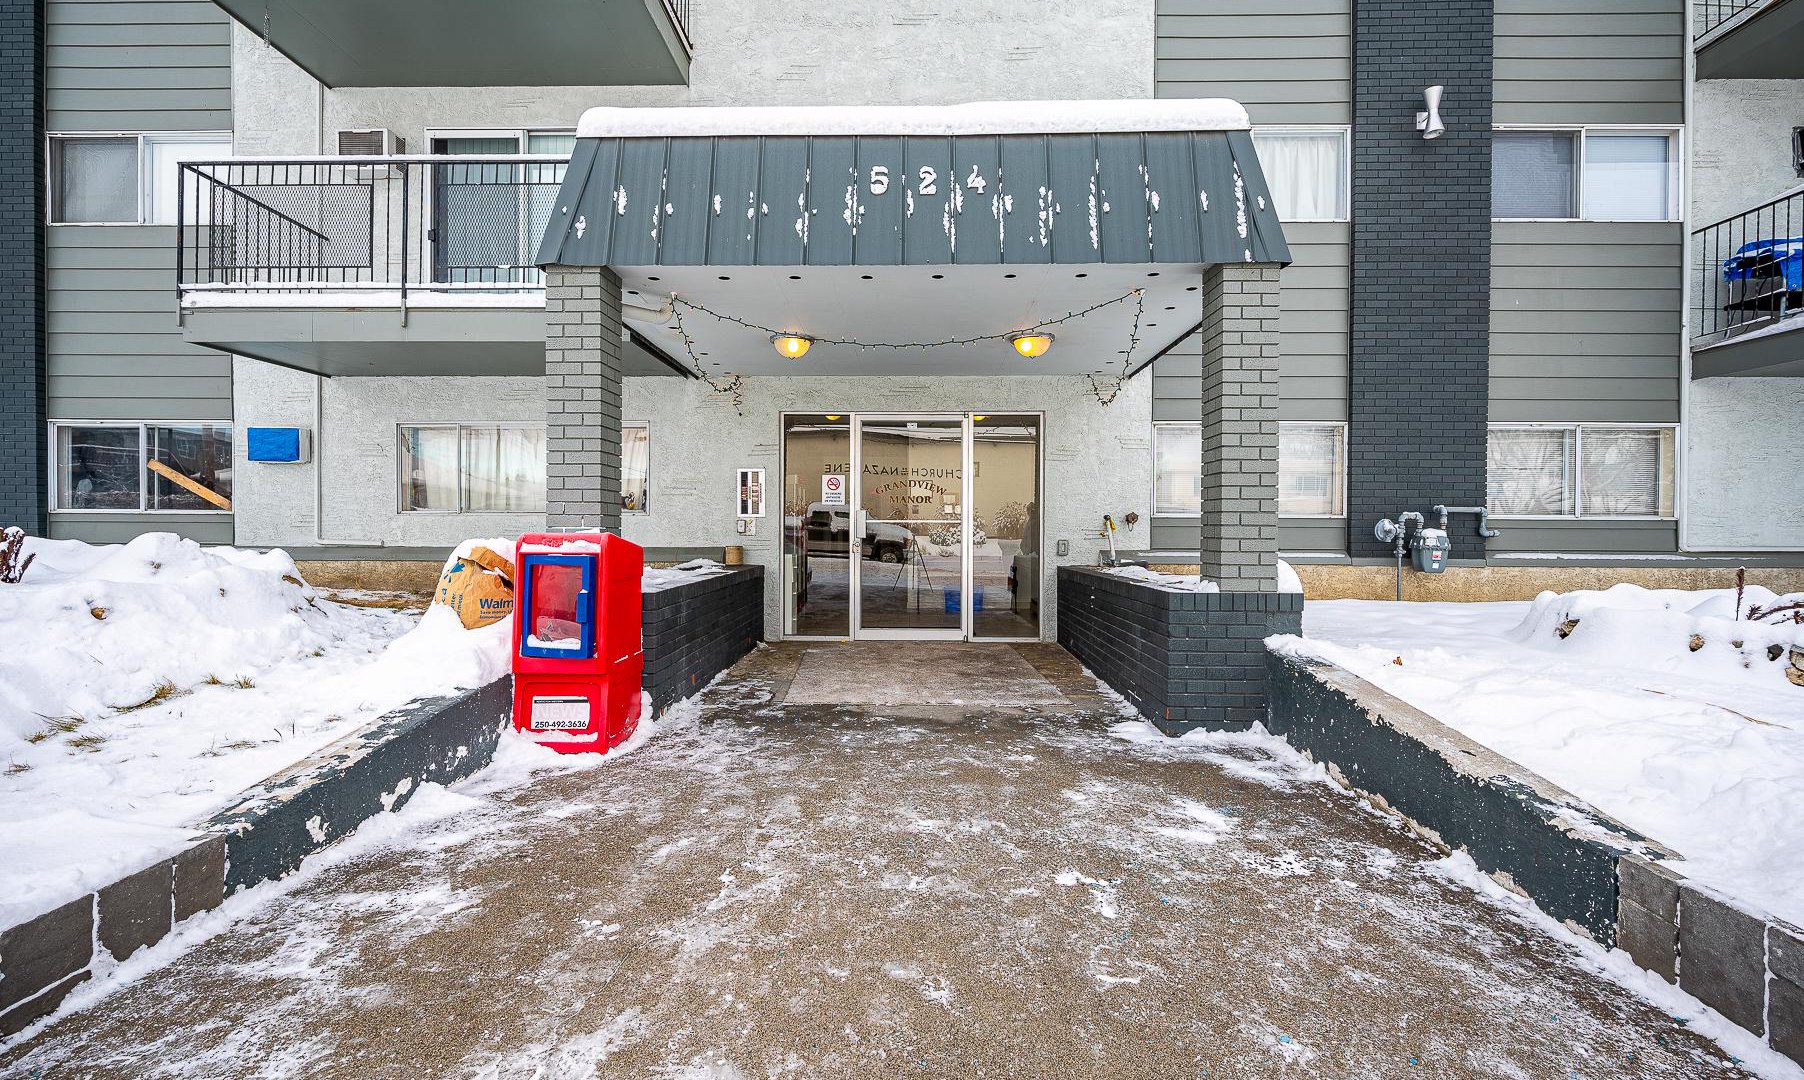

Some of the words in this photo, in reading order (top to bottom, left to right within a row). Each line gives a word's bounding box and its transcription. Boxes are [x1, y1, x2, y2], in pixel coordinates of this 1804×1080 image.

[870, 165, 987, 195] 524
[875, 480, 947, 496] GRANDVIEW
[889, 495, 932, 504] MANOR
[534, 720, 587, 728] 250-492-3636
